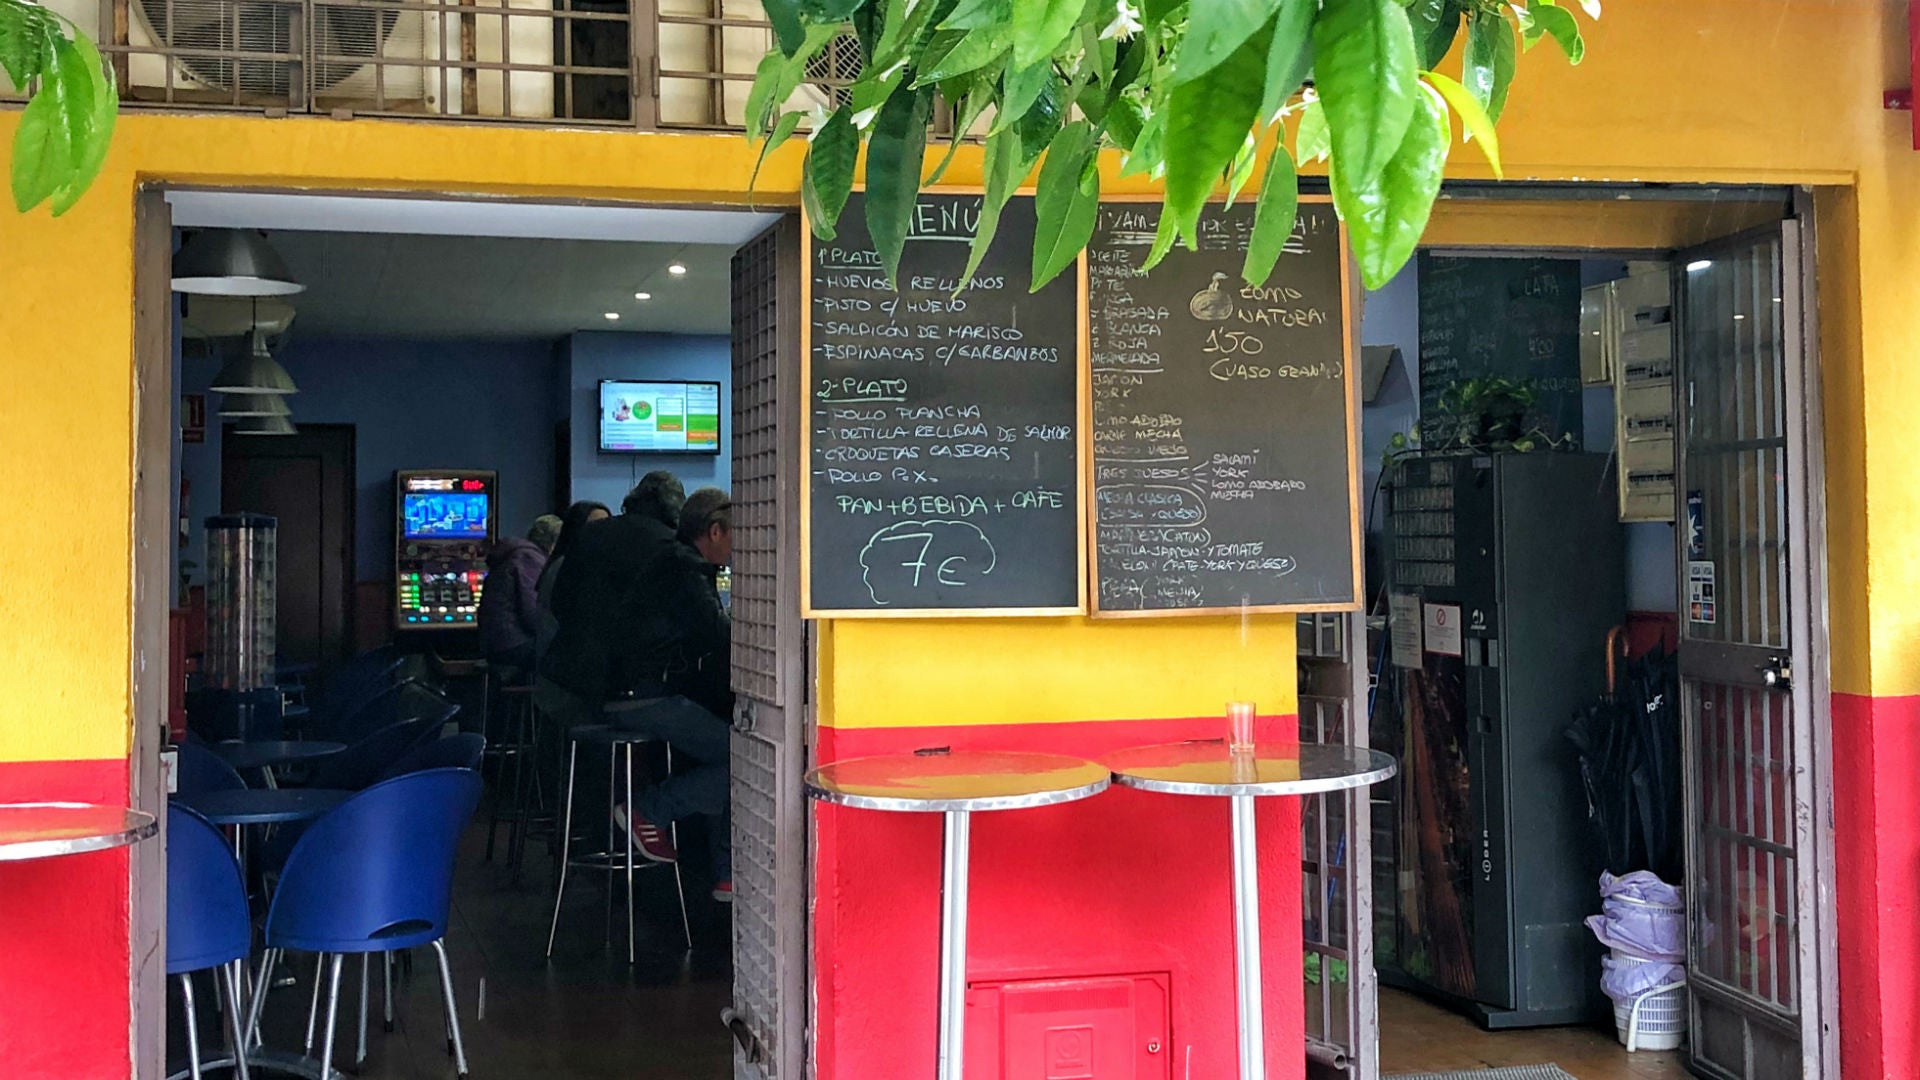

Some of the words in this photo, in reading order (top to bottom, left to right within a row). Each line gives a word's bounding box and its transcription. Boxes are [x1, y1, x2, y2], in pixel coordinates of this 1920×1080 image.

[908, 199, 983, 233] ENÚ
[907, 301, 966, 313] HUEVO
[1238, 308, 1327, 327] NATURA
[917, 325, 940, 339] DE
[948, 325, 1023, 340] MARISCO
[843, 377, 907, 397] PLATO
[896, 405, 981, 420] PLANCHA
[915, 424, 988, 439] RELLENA
[997, 426, 1017, 441] DE
[930, 445, 1010, 461] CASERAS
[1212, 467, 1249, 478] YORK
[1211, 479, 1245, 489] LOMO
